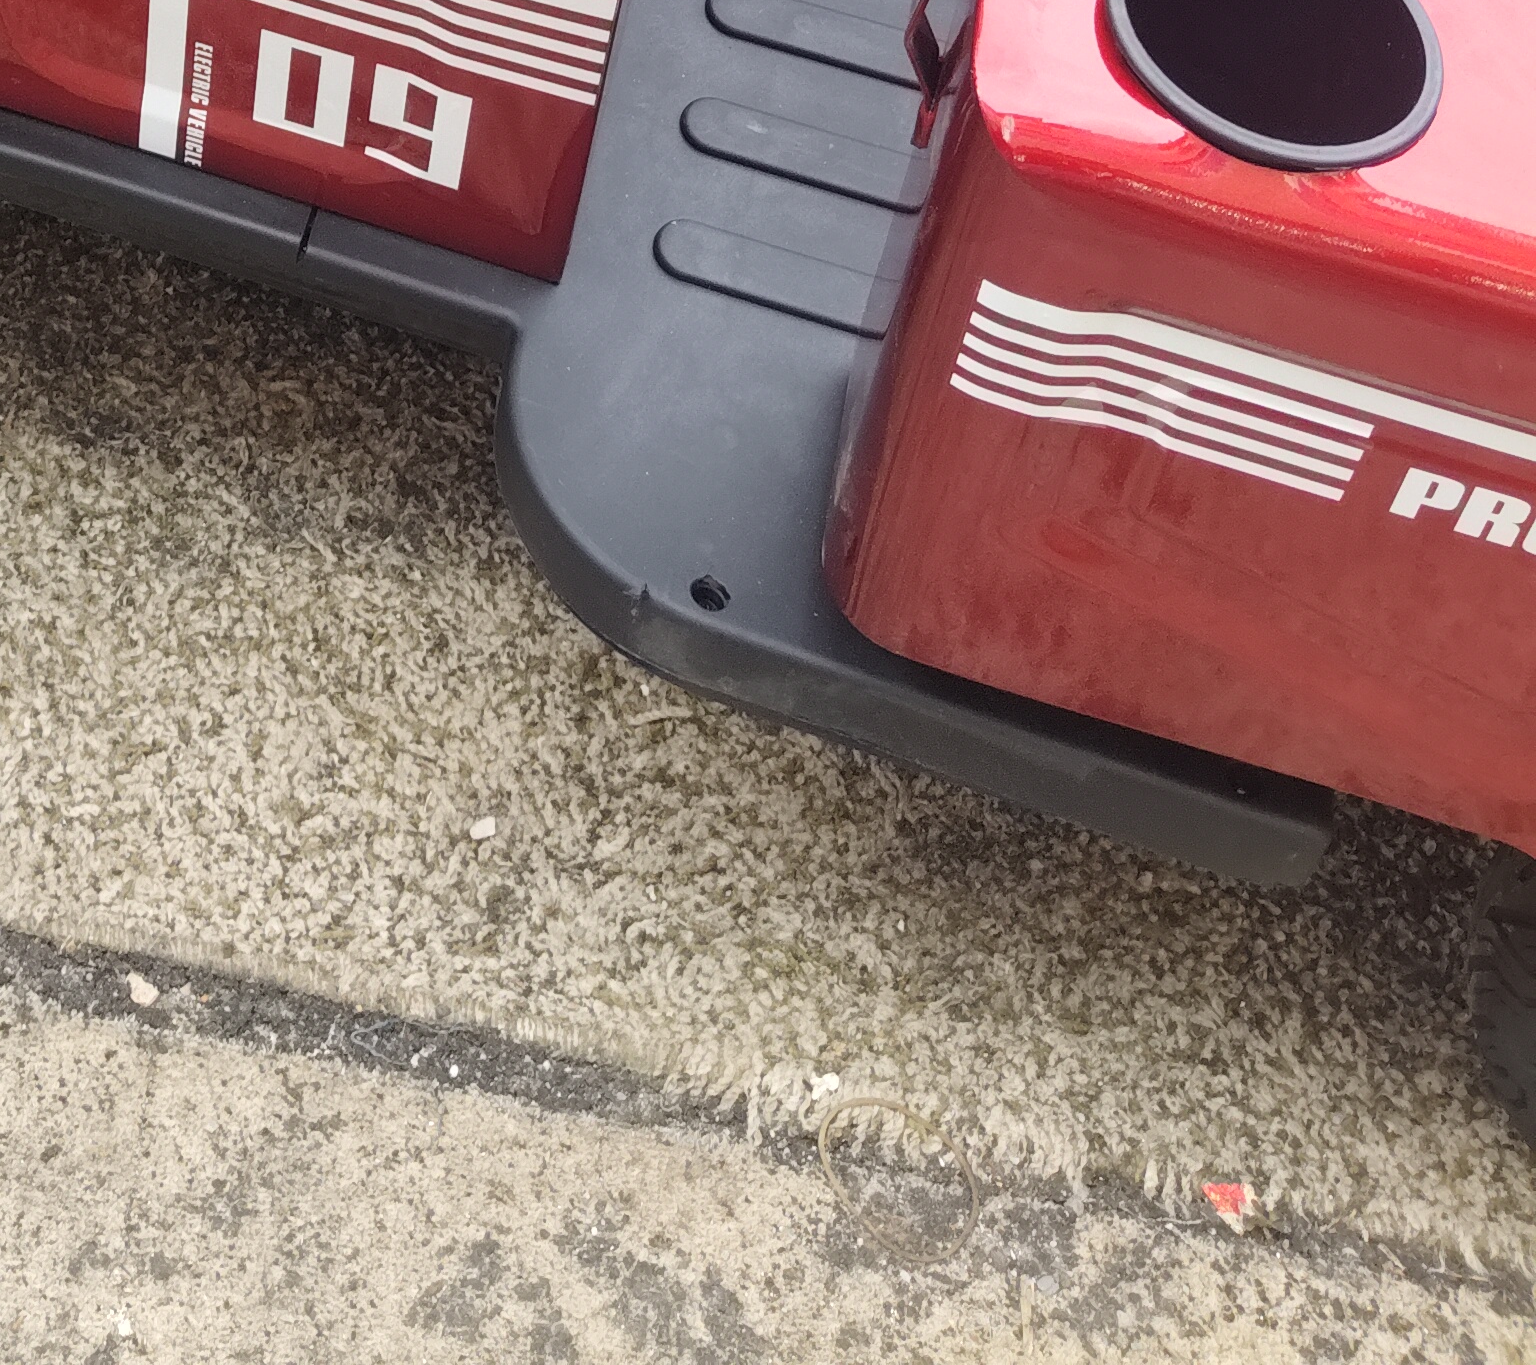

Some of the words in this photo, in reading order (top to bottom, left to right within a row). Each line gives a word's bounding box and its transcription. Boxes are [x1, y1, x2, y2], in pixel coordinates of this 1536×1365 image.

[191, 41, 214, 106] ELECTRIC
[252, 28, 473, 191] 09
[184, 107, 207, 168] VEHICLE
[1388, 467, 1536, 556] PR
